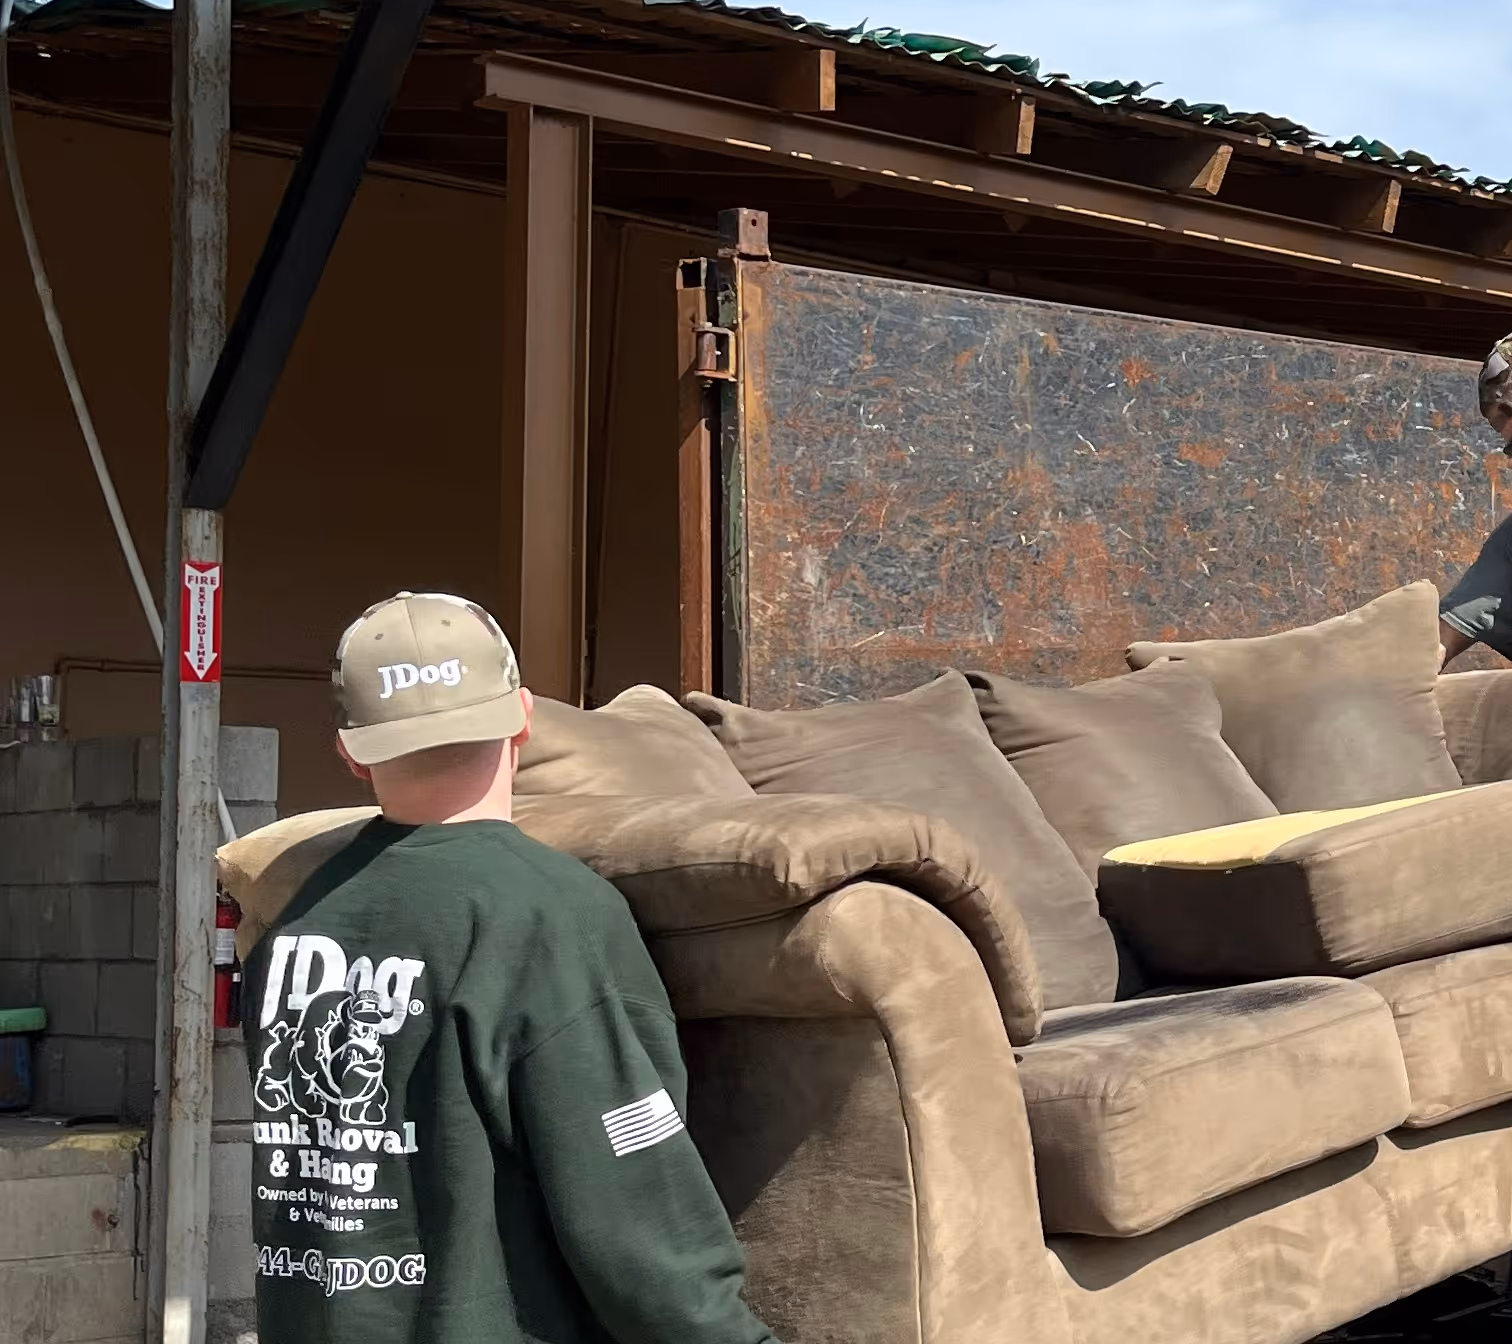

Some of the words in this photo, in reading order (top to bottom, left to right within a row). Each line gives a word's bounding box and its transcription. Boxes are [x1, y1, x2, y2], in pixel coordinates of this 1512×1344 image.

[187, 575, 217, 586] FIRE
[196, 587, 207, 671] EXTINGUISHER
[377, 658, 462, 699] JDog
[259, 934, 426, 1036] JDog
[253, 1113, 312, 1146] unk
[269, 1149, 290, 1178] &
[256, 1185, 307, 1203] Owned
[330, 1195, 399, 1211] Veterans
[289, 1207, 301, 1222] &
